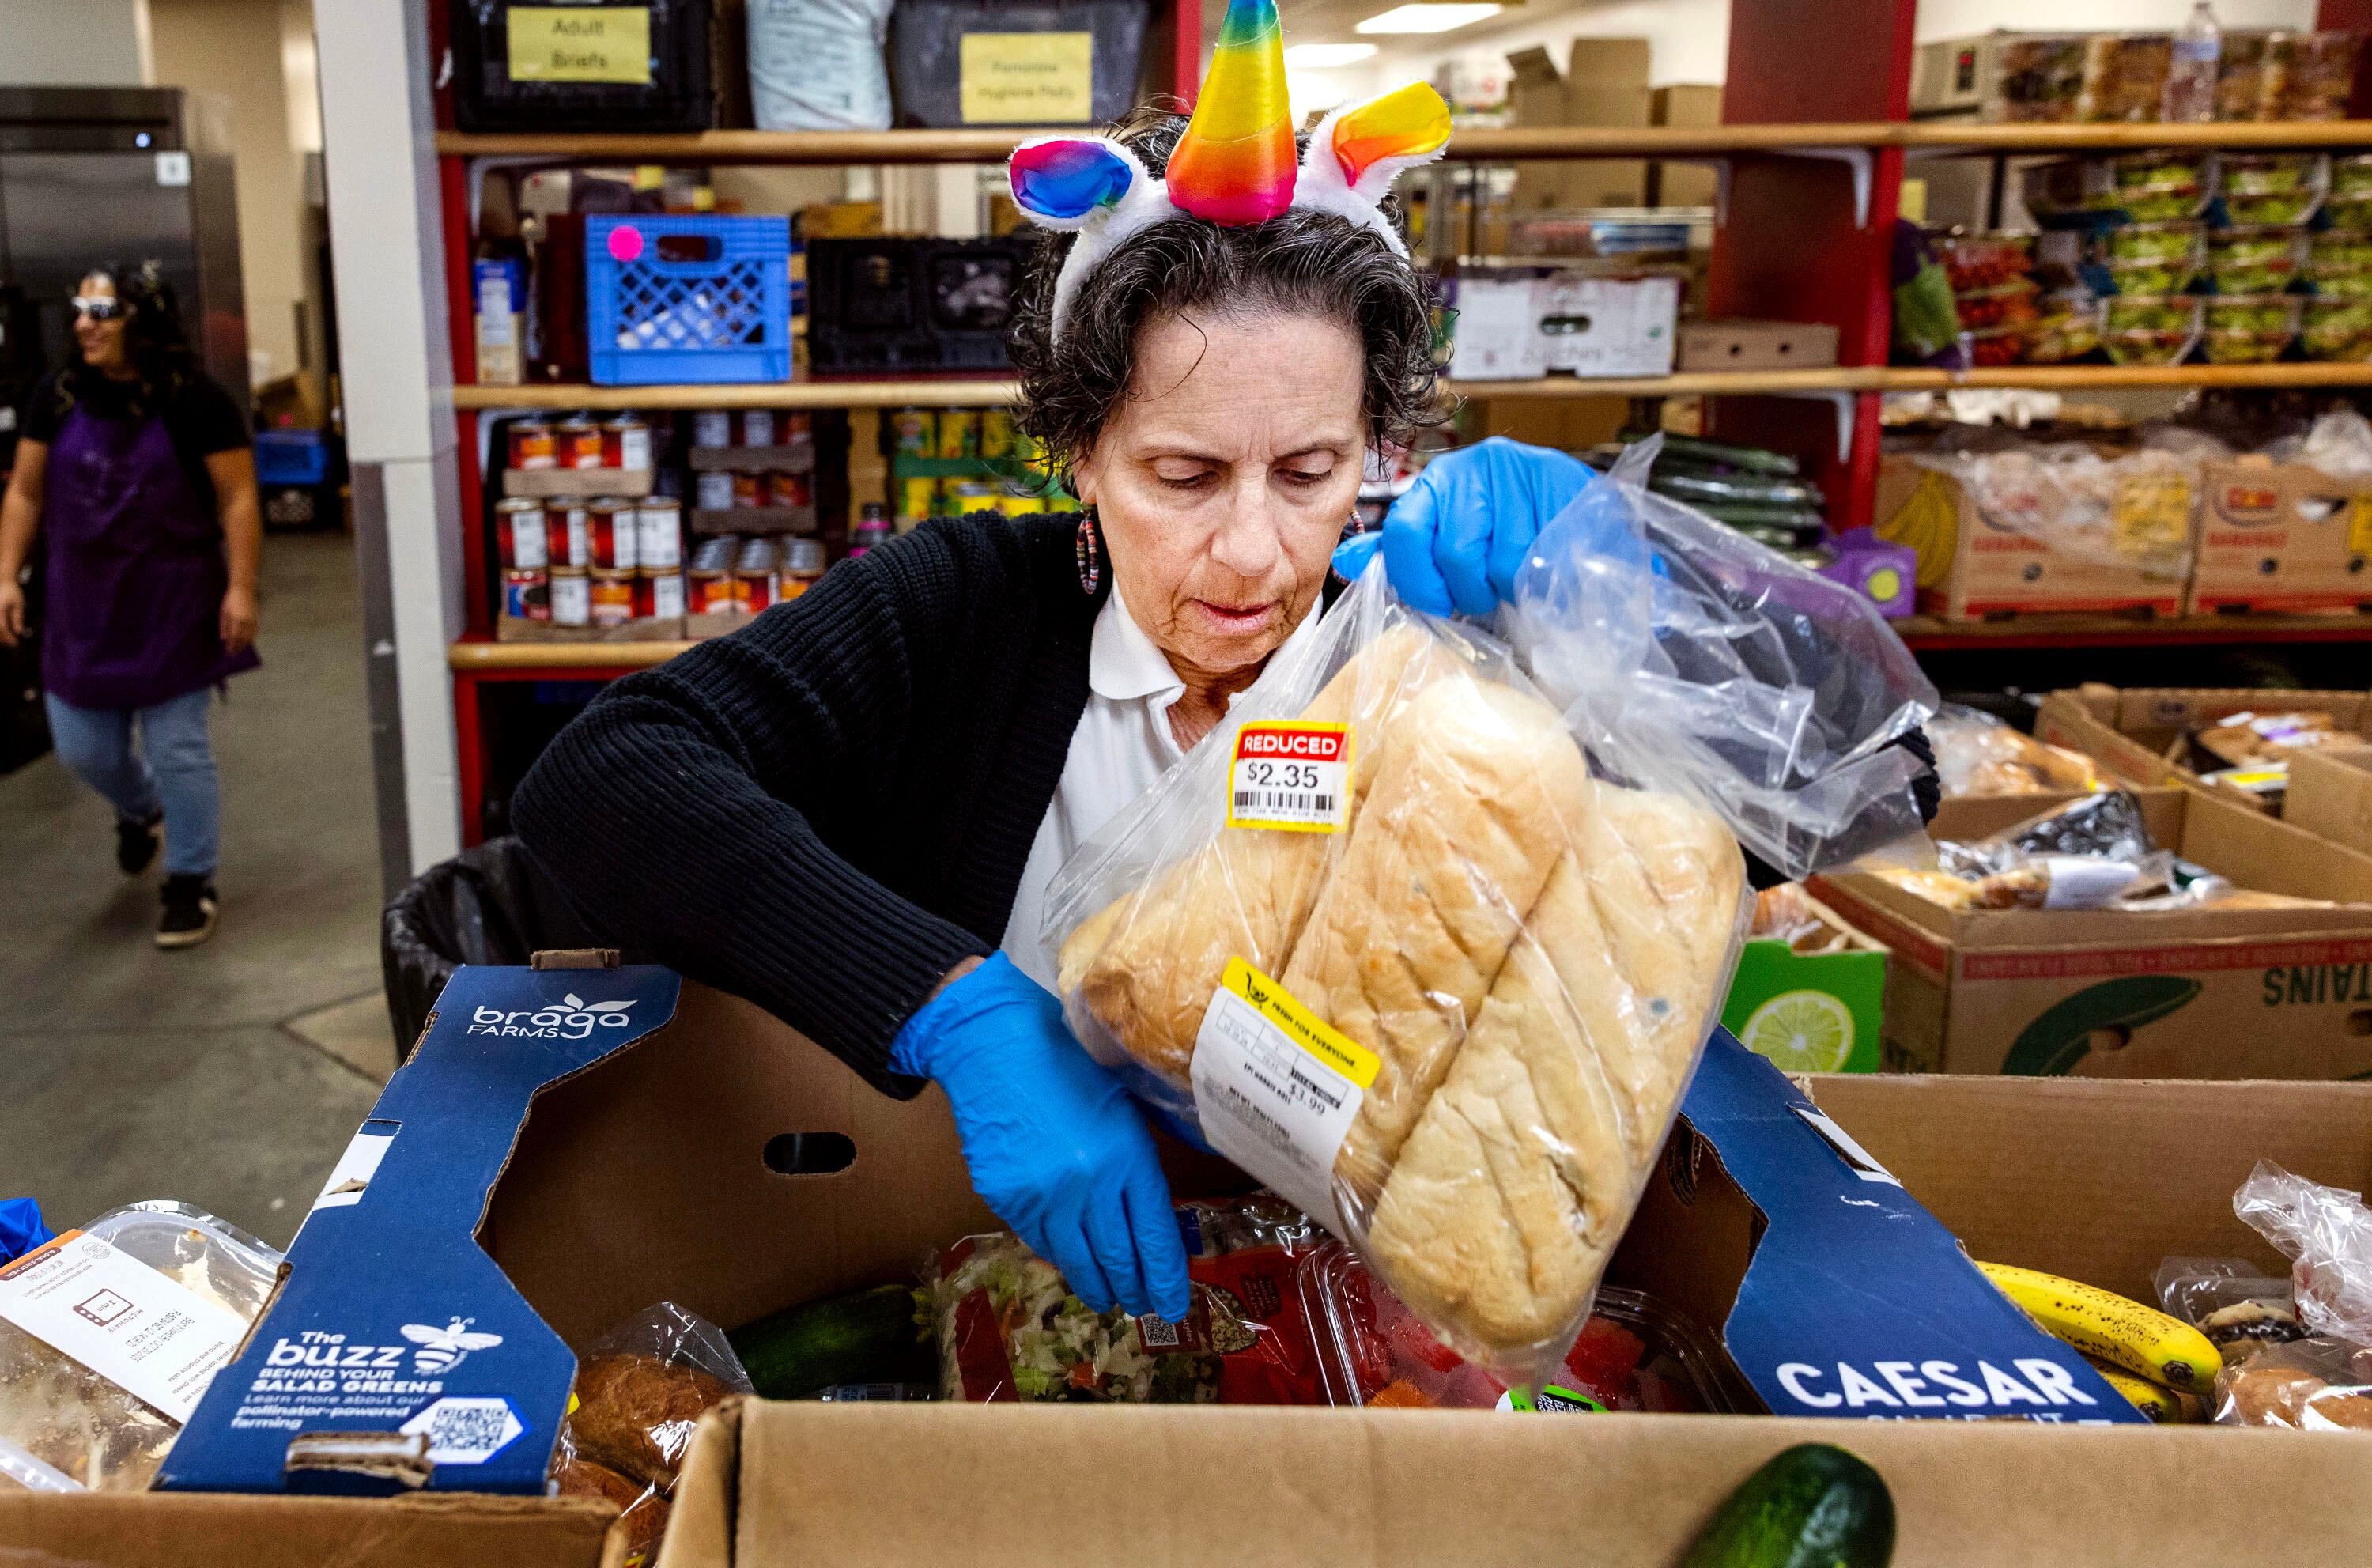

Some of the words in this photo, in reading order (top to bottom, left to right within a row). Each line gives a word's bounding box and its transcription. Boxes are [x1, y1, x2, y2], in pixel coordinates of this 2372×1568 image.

[552, 20, 603, 36] Adult
[551, 50, 608, 69] Briefs
[1244, 735, 1337, 755] REDUCED
[1248, 762, 1319, 788] $2.35
[473, 1006, 629, 1039] braga
[466, 1025, 559, 1038] FARMS
[1288, 1083, 1326, 1116] $3.99
[18, 1249, 55, 1271] GLOBAL-STYLE
[96, 1302, 110, 1313] min
[107, 1309, 144, 1333] MICROWAVE
[300, 1332, 346, 1344] The
[266, 1339, 406, 1367] buzz
[259, 1368, 335, 1381] BEHIND
[338, 1369, 395, 1381] YOUR
[1776, 1358, 2098, 1407] CAESAR
[250, 1380, 338, 1392] SALAD
[342, 1381, 443, 1394] GREENS
[245, 1393, 291, 1404] Learn
[344, 1395, 393, 1405] about
[236, 1404, 410, 1418] pollinator-powered
[231, 1417, 304, 1430] farming
